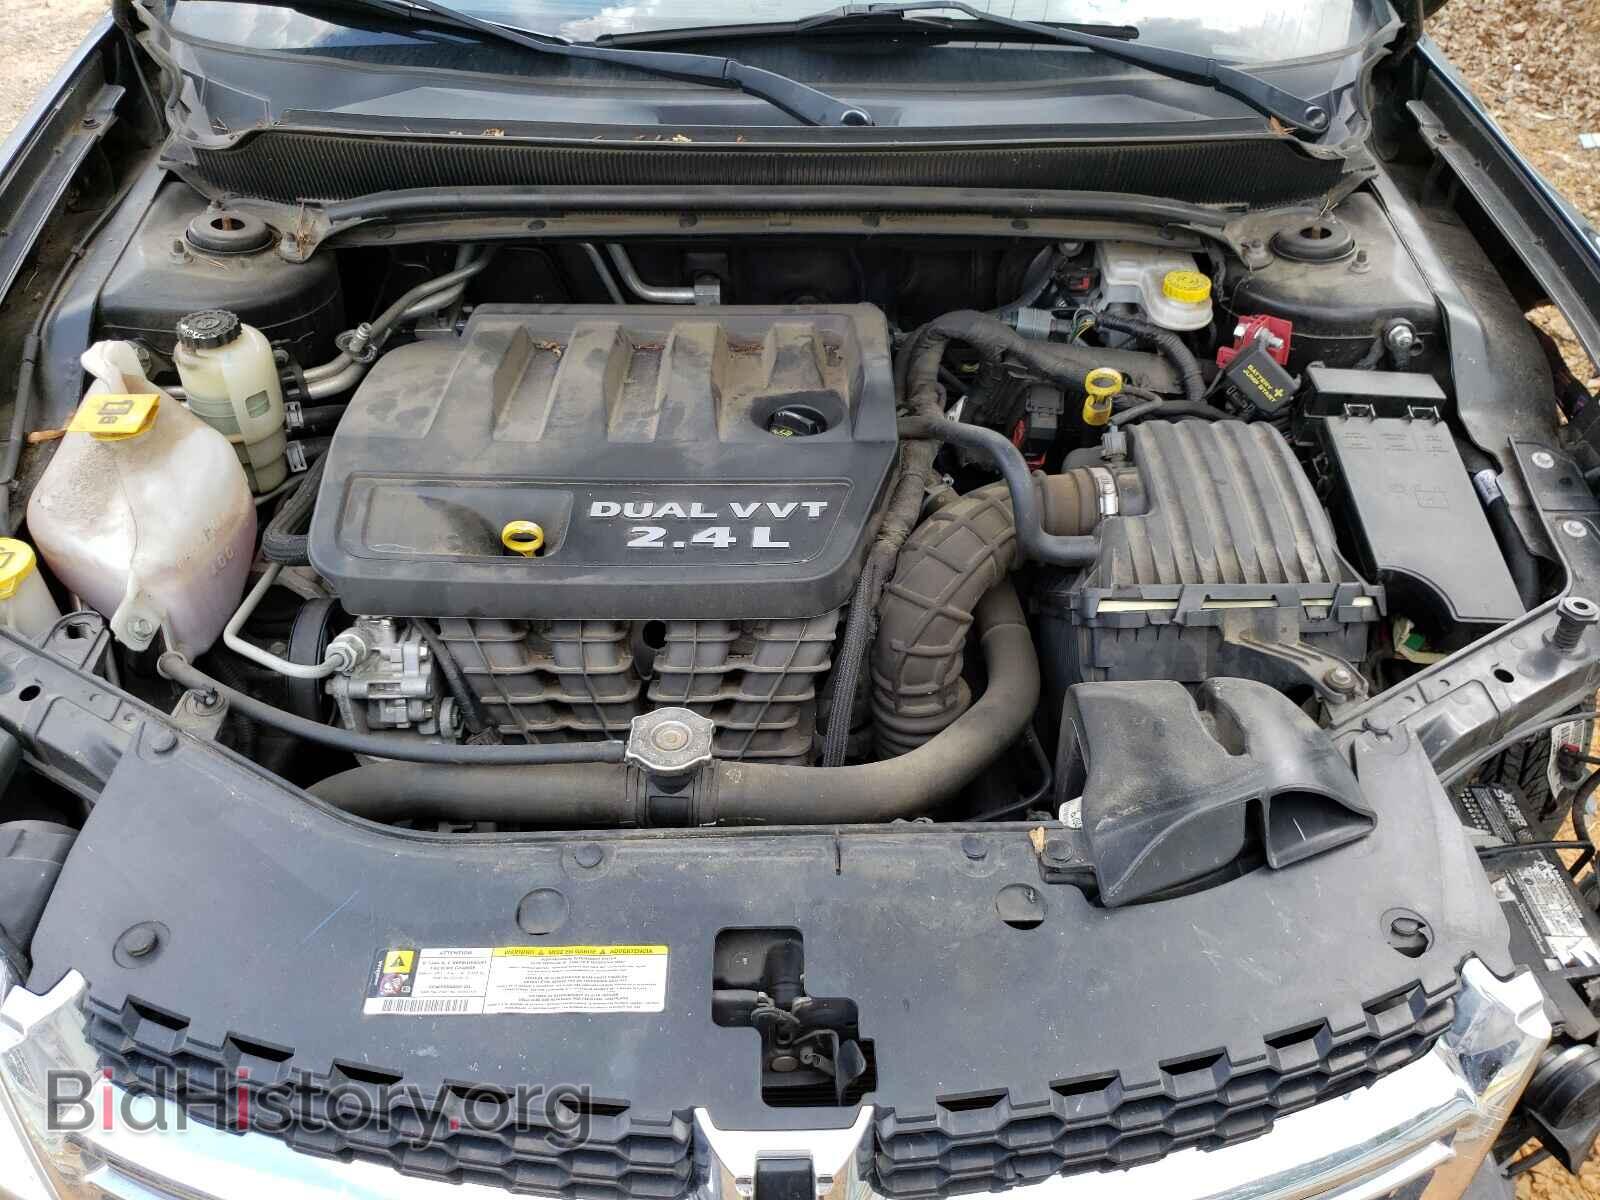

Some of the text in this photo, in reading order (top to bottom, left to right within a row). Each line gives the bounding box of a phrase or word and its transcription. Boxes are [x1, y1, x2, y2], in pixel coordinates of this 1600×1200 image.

[1246, 363, 1273, 390] BATTERY
[589, 501, 829, 520] DUAL VVT
